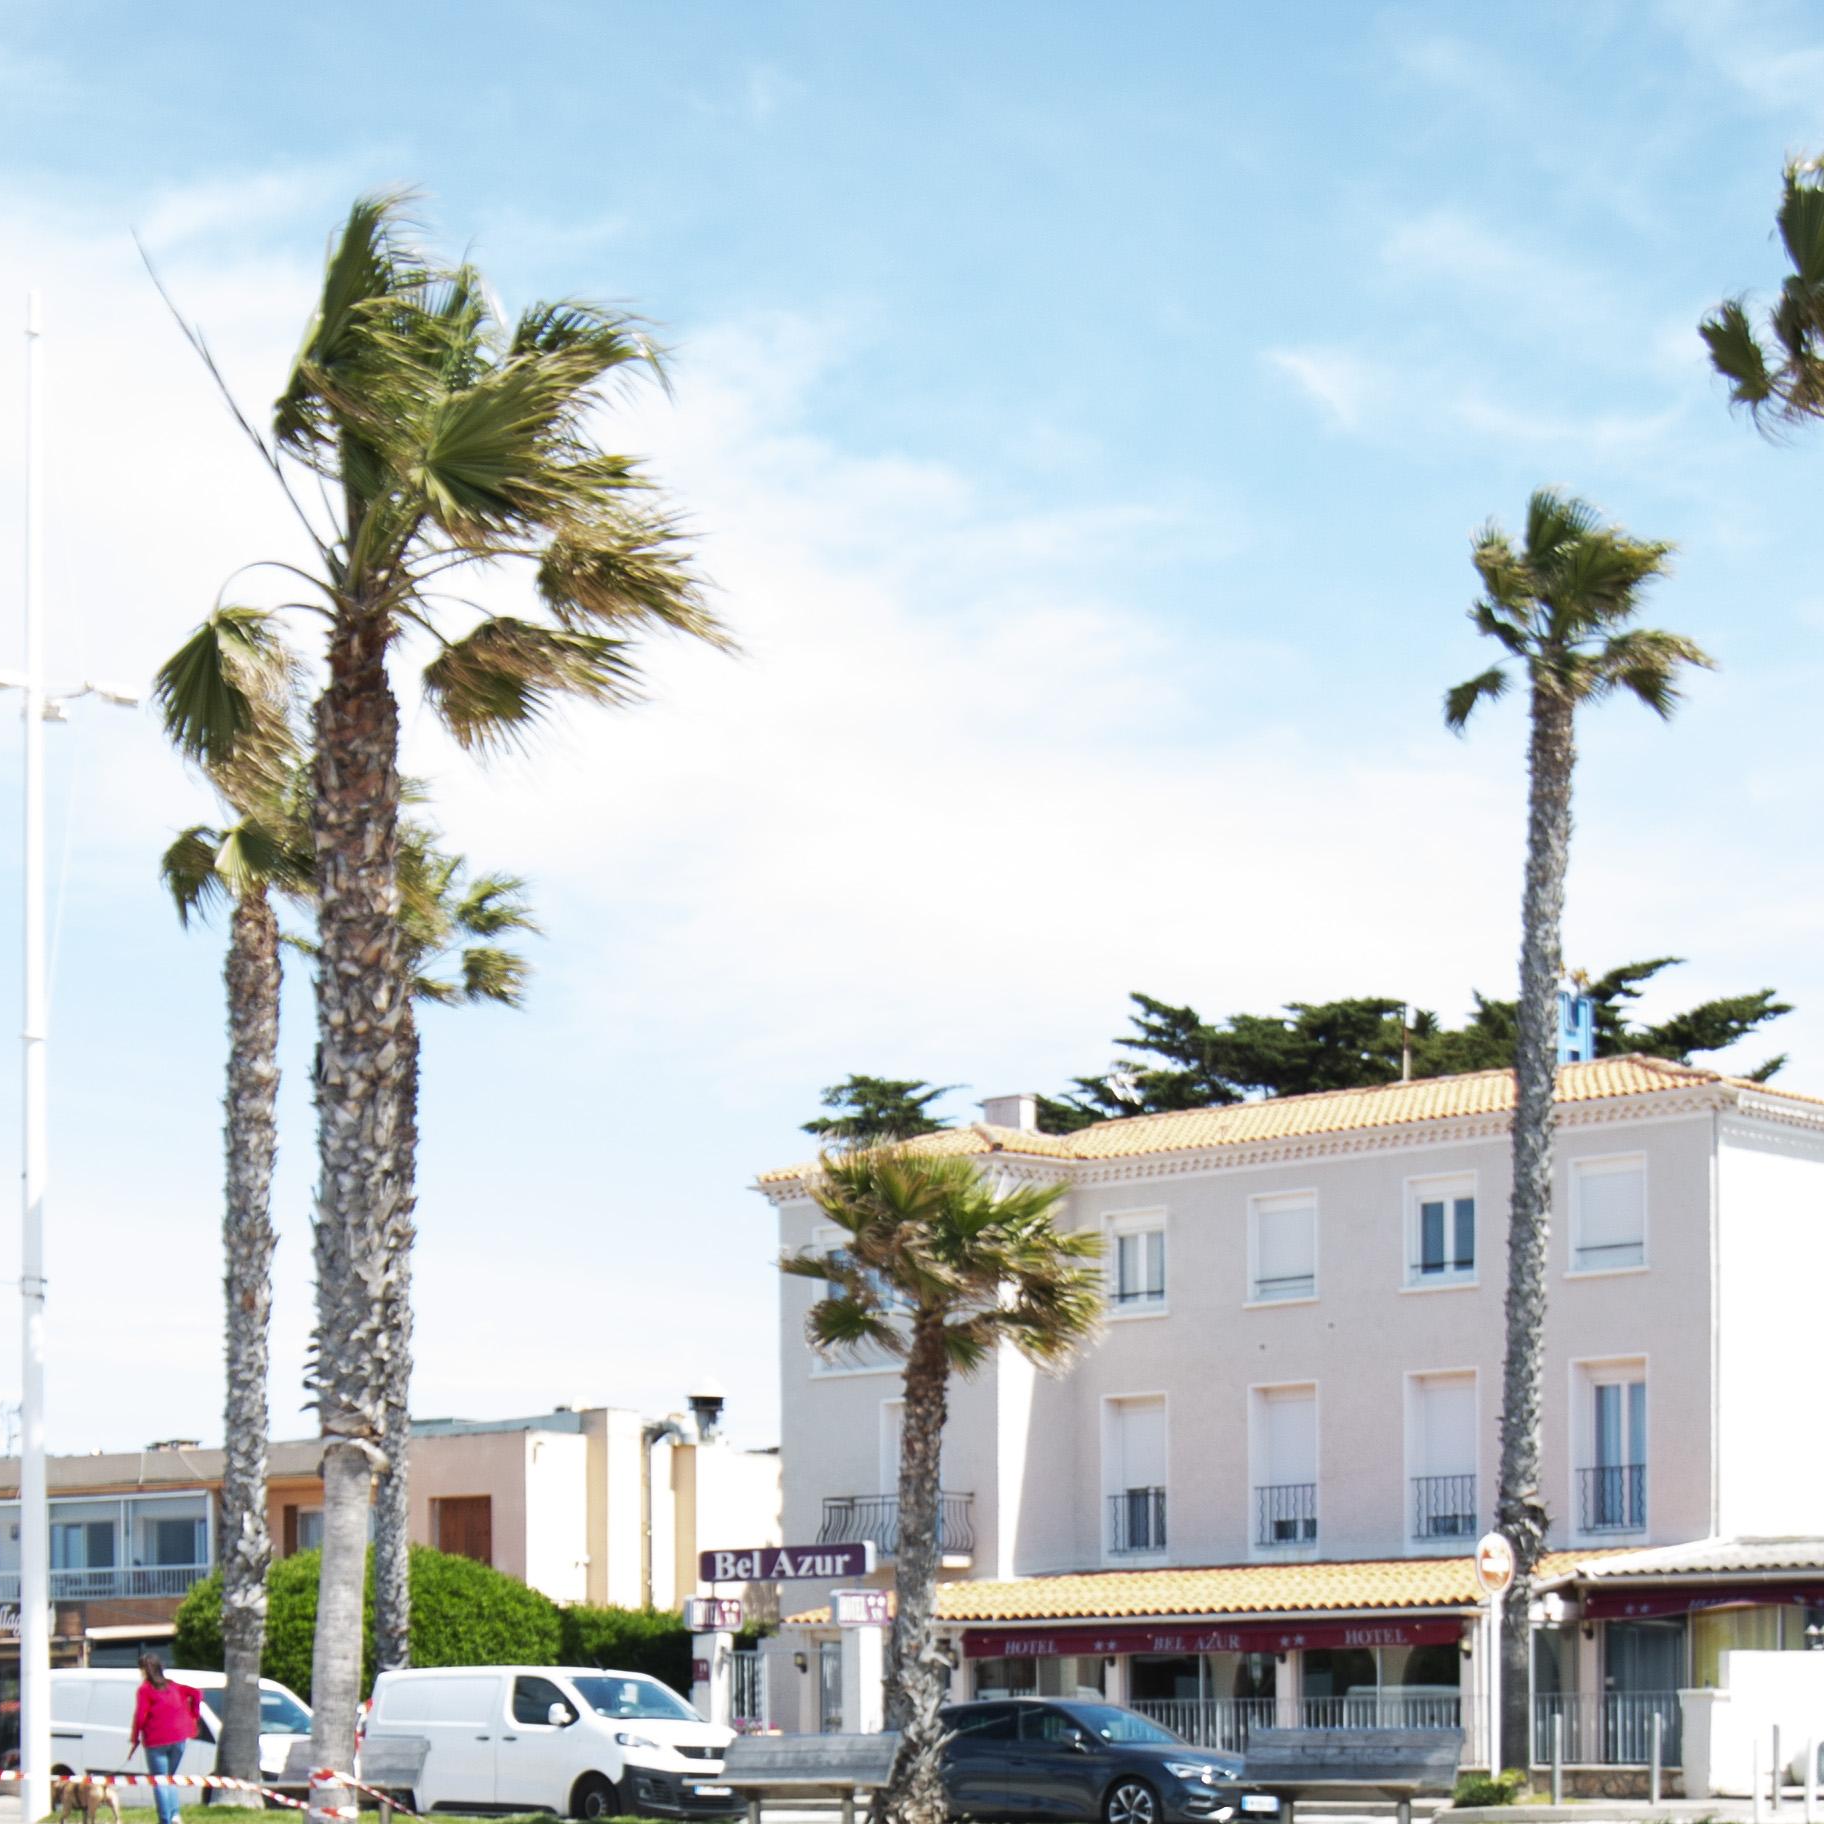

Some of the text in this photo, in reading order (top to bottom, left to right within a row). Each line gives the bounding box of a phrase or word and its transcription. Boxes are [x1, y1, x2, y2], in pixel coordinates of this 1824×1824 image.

[713, 1549, 851, 1580] Bel Azur
[1005, 1628, 1408, 1655] HOTEL BEL AZUR HOTEL
